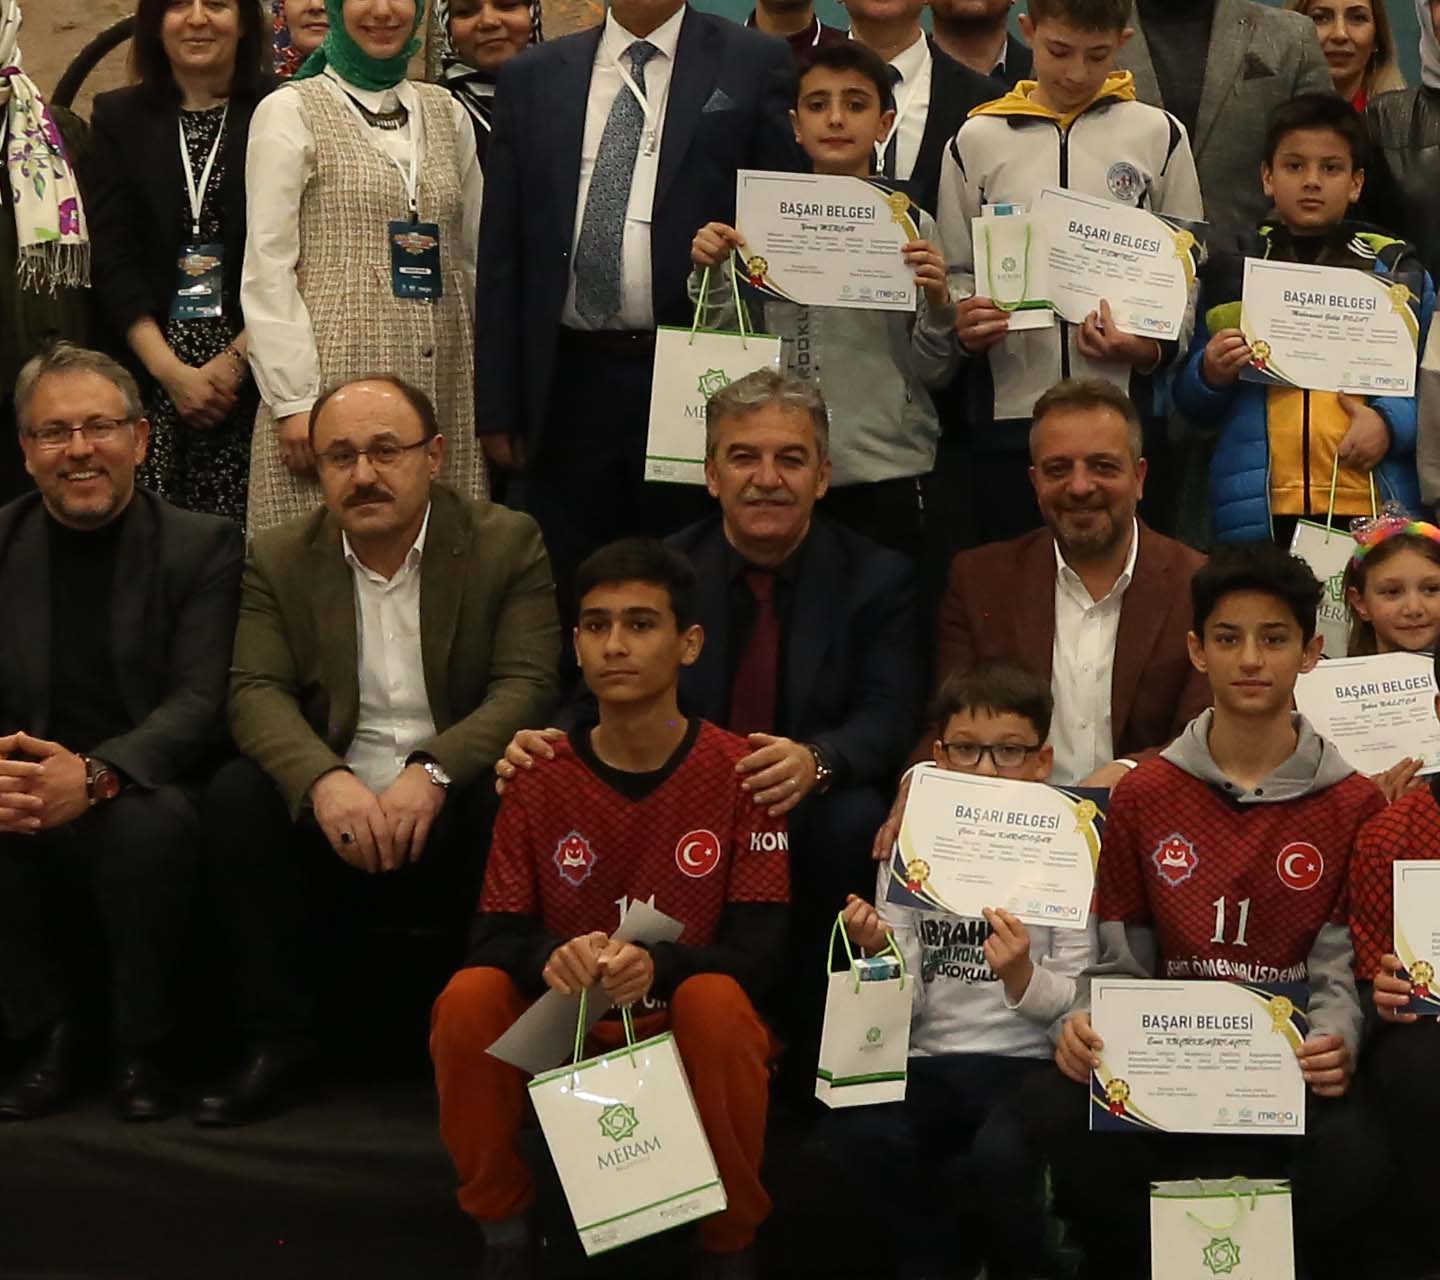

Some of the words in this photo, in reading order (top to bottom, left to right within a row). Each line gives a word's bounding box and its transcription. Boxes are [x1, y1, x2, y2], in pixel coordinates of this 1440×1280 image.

[779, 201, 824, 218] BAŞARI
[826, 204, 876, 220] BELGESİ
[1068, 220, 1111, 241] BAŞARI
[1113, 231, 1161, 254] BELGESİ
[1283, 289, 1327, 307] BAŞARI
[1329, 295, 1377, 311] BELGESİ
[1335, 683, 1381, 699] BAŞARI
[1383, 673, 1434, 694] BELGESİ
[954, 804, 1004, 824] BAŞARI
[1006, 812, 1061, 831] BELGESİ
[749, 831, 790, 852] KON
[1209, 894, 1252, 948] 11
[1142, 1014, 1192, 1033] BAŞARI
[1196, 1012, 1254, 1031] BELGESİ
[597, 1136, 662, 1171] MERAM
